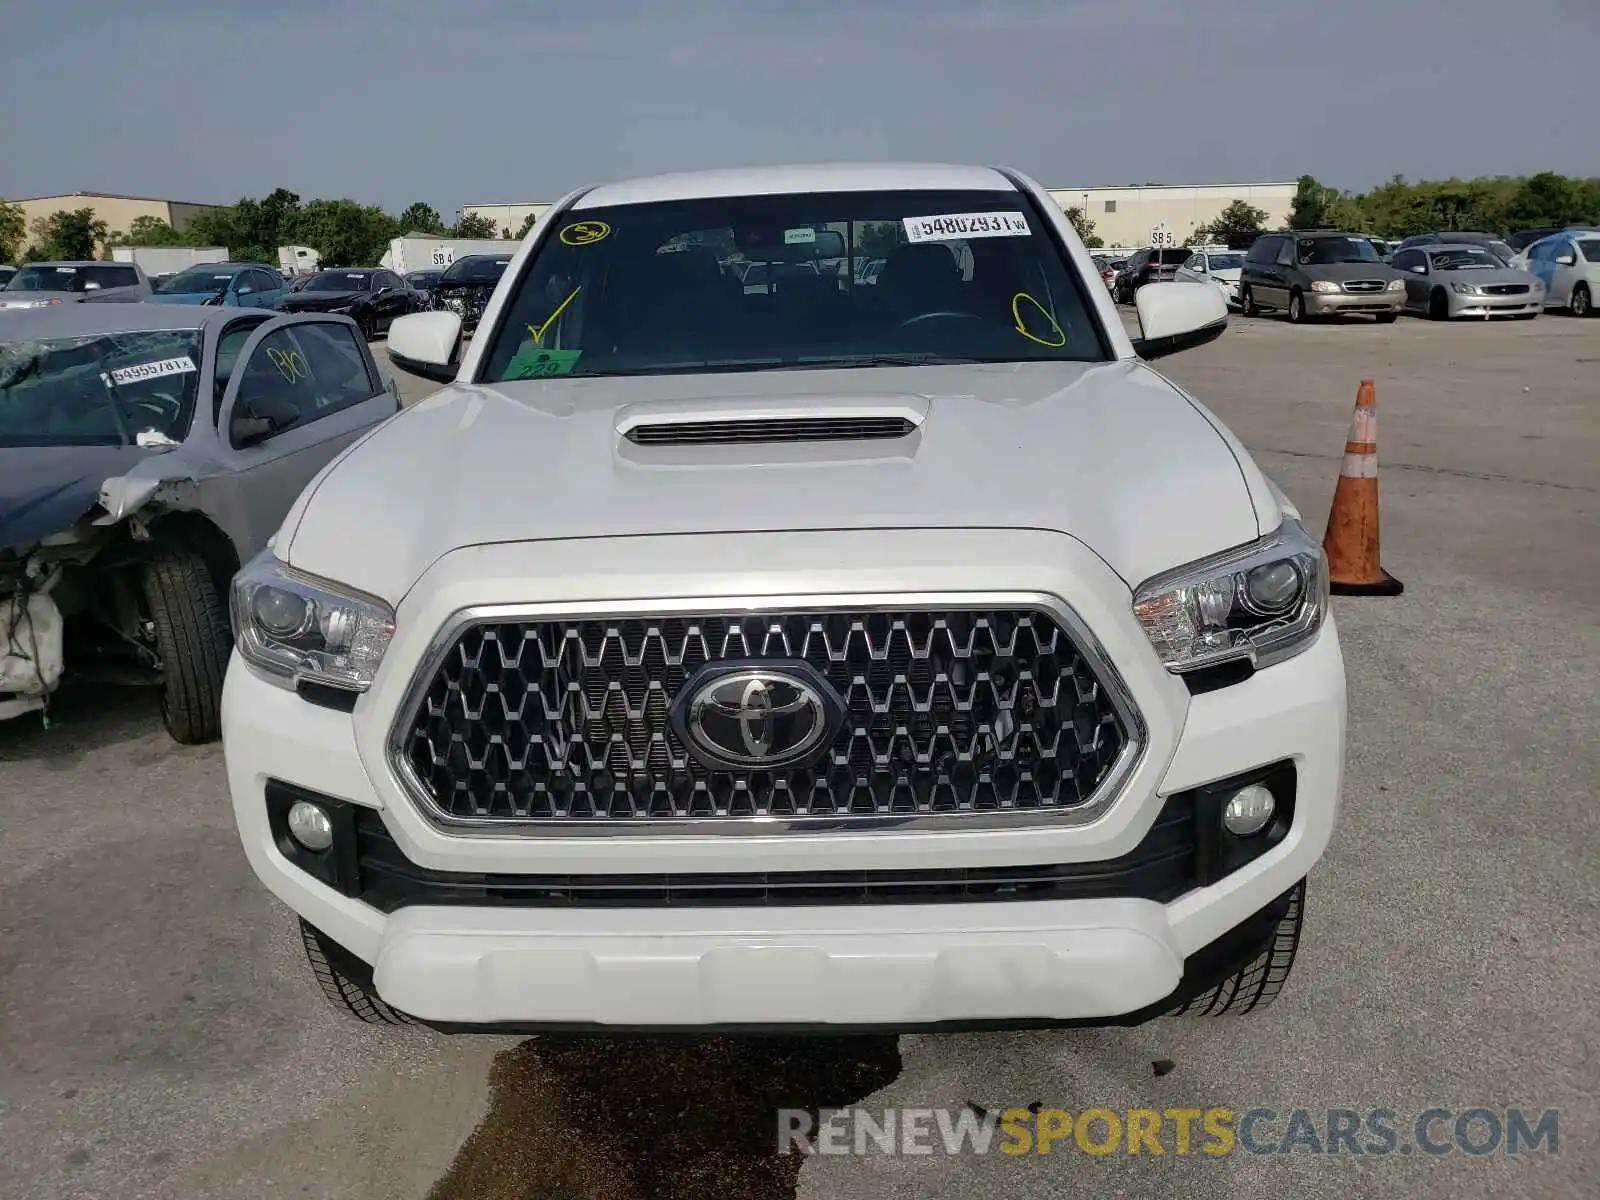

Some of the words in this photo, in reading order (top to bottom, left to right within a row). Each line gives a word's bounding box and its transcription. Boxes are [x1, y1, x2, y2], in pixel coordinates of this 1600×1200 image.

[1152, 232, 1164, 244] SB
[1166, 232, 1172, 244] 5
[433, 253, 444, 265] SB
